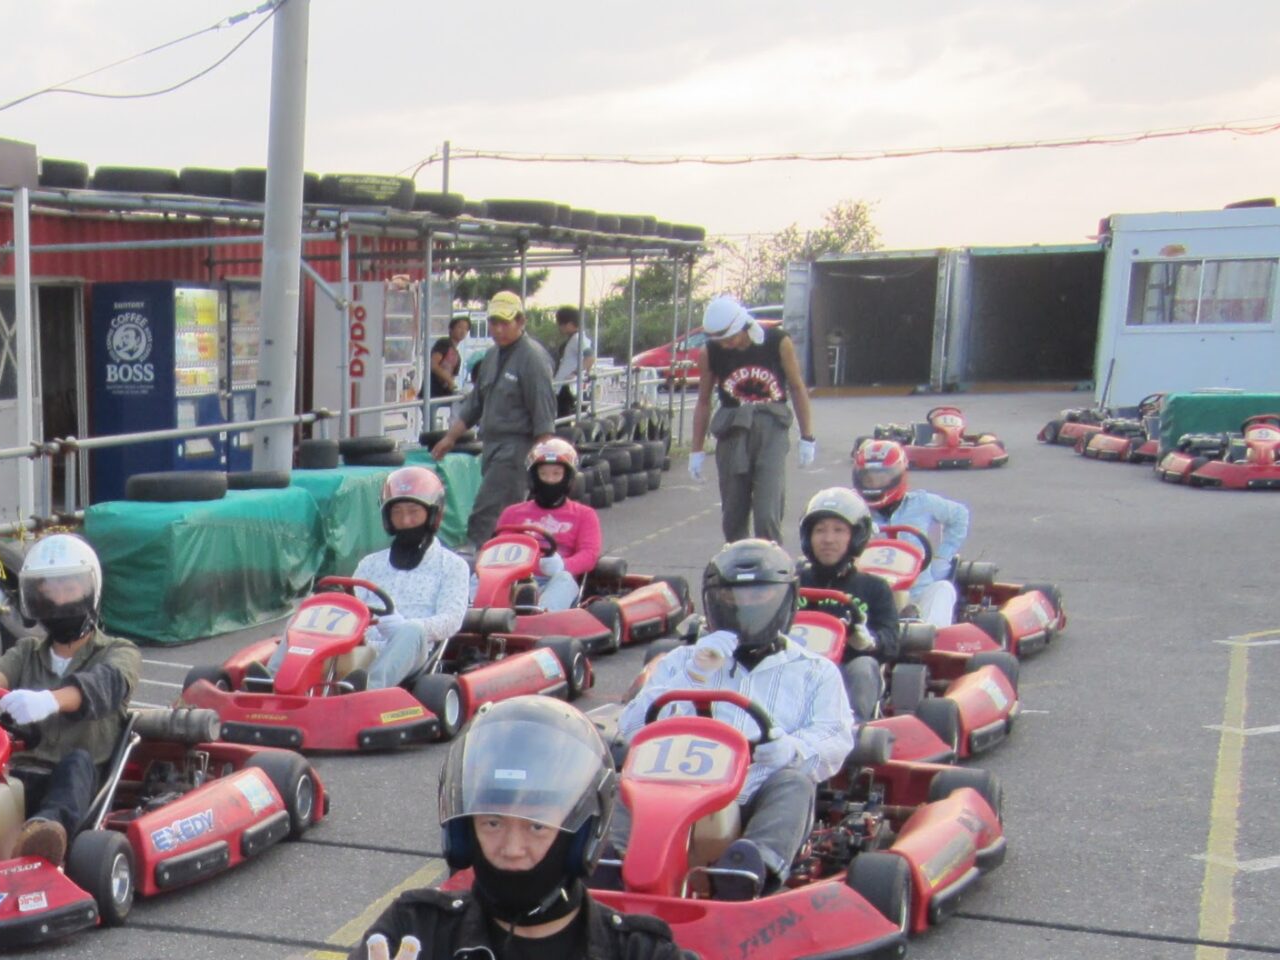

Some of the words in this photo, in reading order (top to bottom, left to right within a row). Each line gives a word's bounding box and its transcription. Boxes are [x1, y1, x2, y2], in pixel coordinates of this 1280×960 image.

[111, 312, 148, 328] COFFEE
[349, 305, 370, 378] DyDo
[106, 363, 155, 382] BOSS
[873, 548, 897, 565] 3
[300, 607, 351, 632] 17
[643, 738, 720, 777] 15
[150, 808, 214, 852] EXEDY
